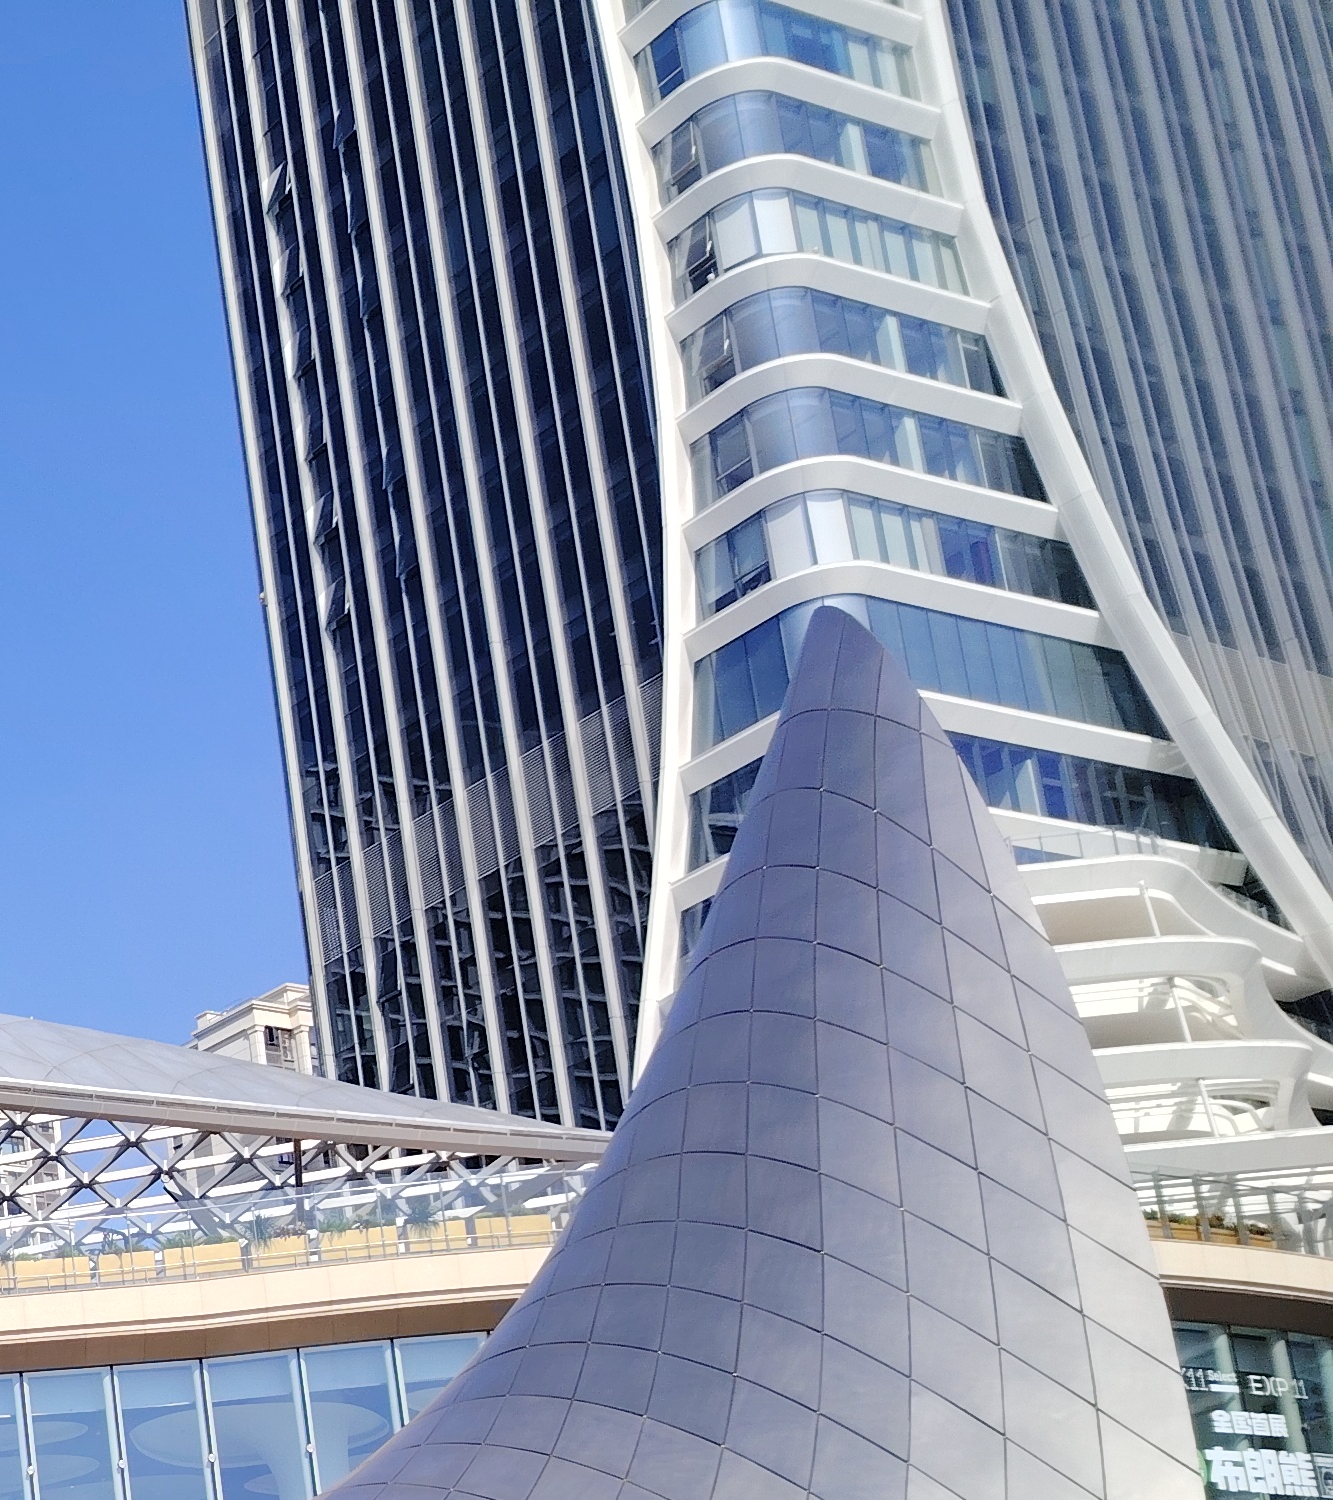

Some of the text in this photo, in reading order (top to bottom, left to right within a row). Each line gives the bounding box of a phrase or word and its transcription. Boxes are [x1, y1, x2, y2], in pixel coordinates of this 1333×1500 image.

[1211, 1410, 1289, 1437] 全国首展
[1204, 1446, 1319, 1497] 布朗熊
